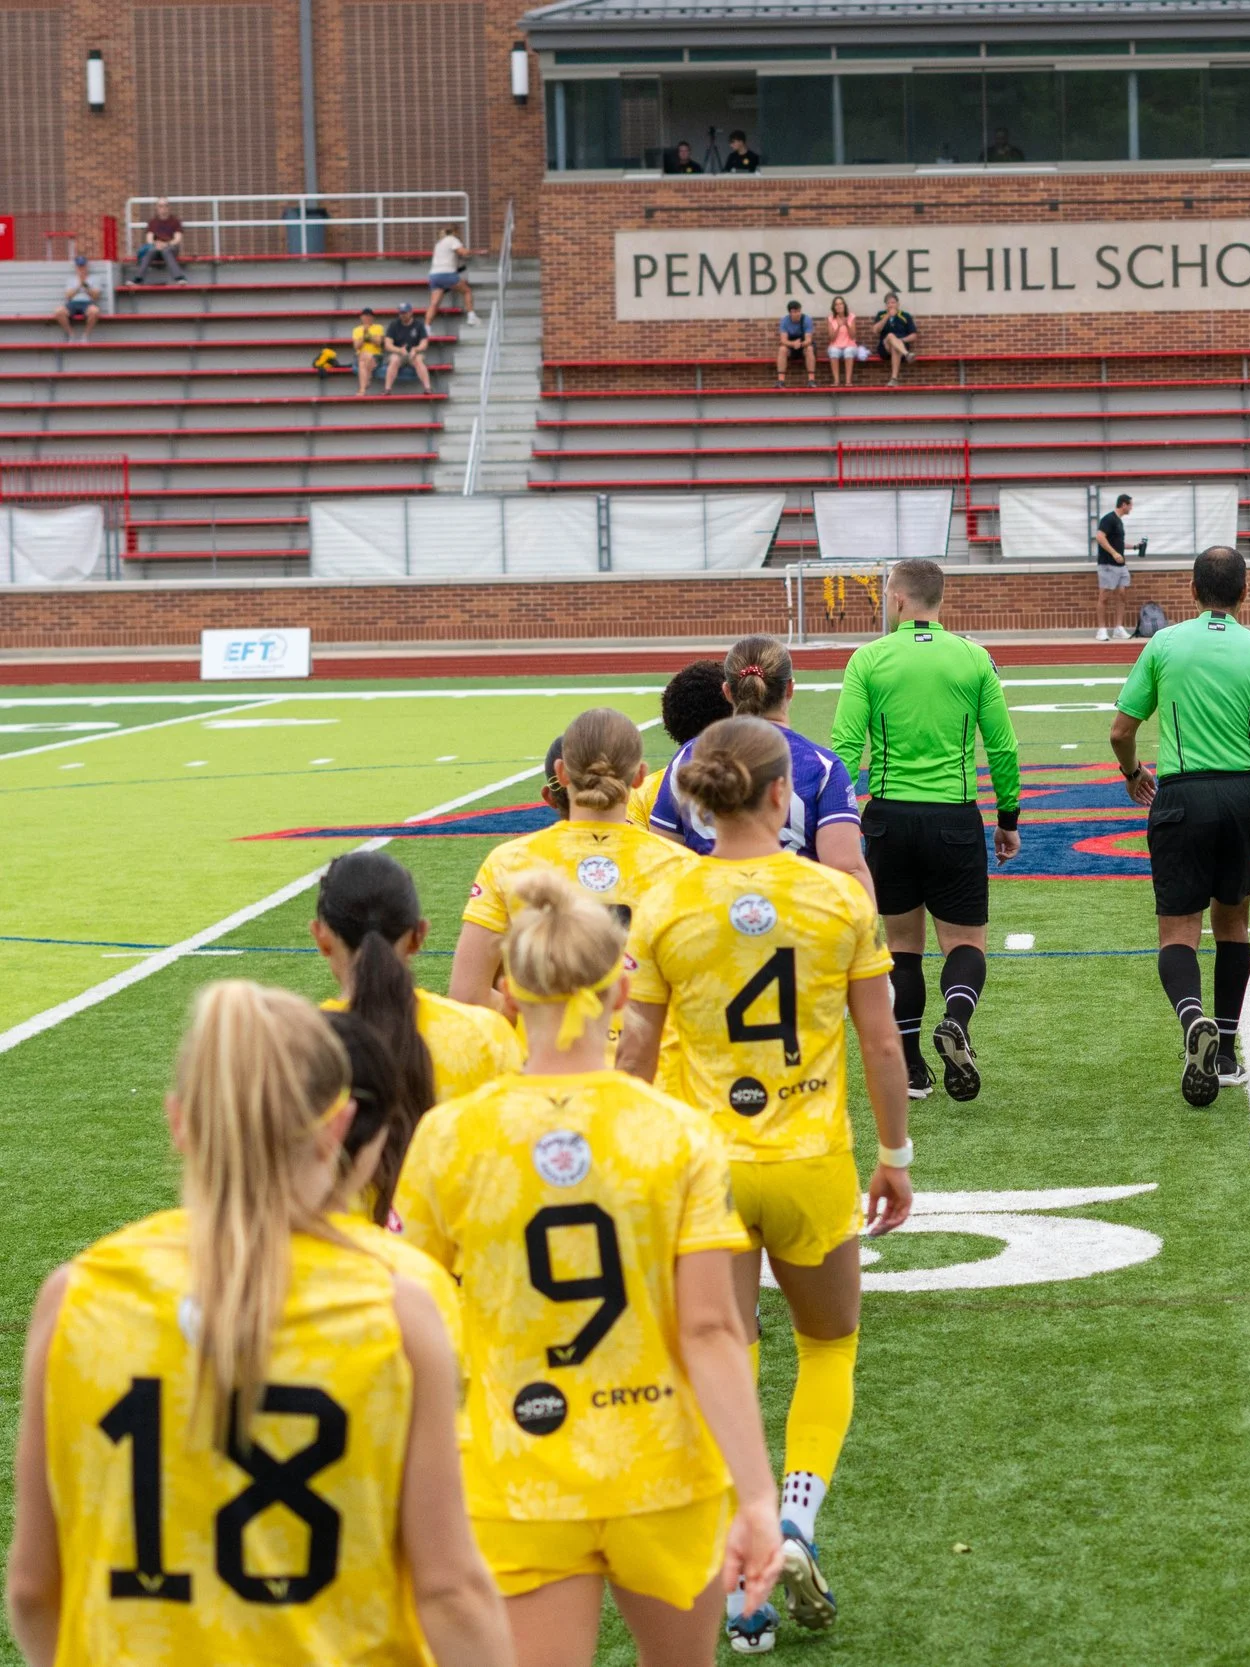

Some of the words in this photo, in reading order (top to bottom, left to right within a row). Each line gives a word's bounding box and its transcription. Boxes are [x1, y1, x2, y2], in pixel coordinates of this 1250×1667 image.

[632, 249, 932, 298] PEMBROKE
[957, 247, 1076, 293] HILL
[225, 640, 276, 662] EFT
[725, 946, 802, 1067] 4
[524, 1202, 629, 1369] 9
[591, 1385, 675, 1409] CRYO+
[97, 1376, 349, 1605] 18
